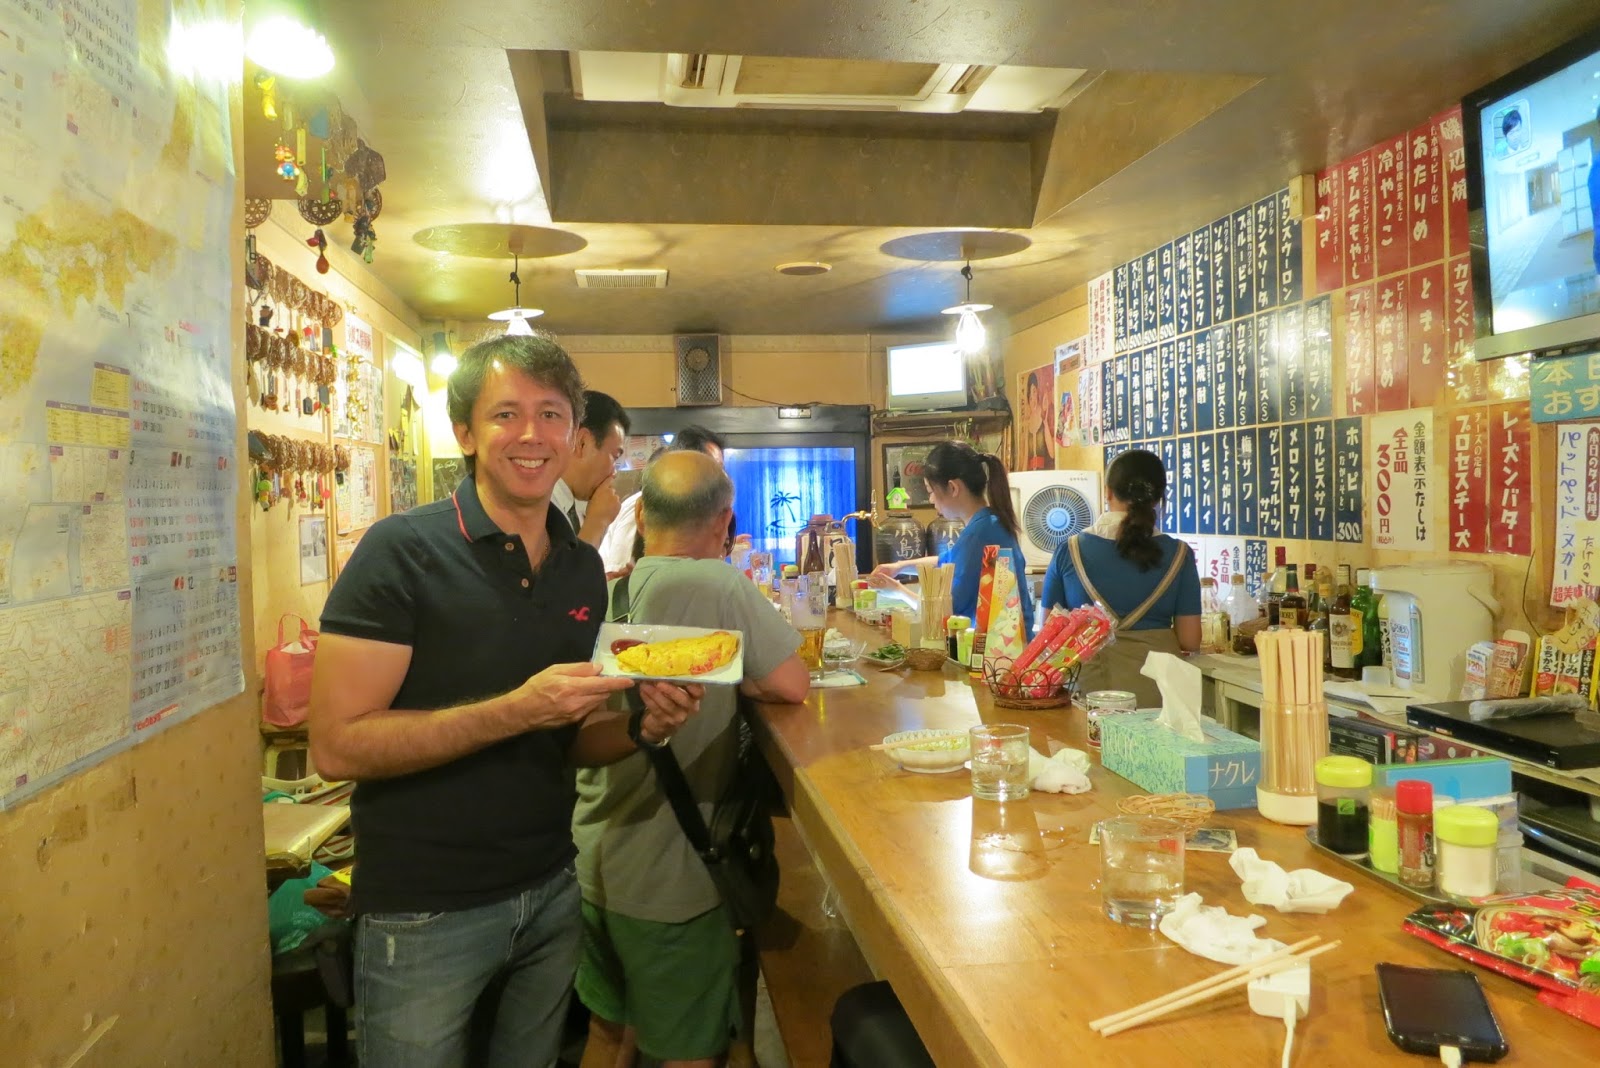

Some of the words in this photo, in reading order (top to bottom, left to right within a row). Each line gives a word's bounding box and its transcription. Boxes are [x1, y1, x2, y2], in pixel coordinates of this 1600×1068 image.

[1348, 166, 1361, 280] キムチもやし
[1378, 150, 1394, 246] 冷やっこ
[1413, 136, 1428, 241] あたりめ
[1147, 256, 1156, 323] 赤ワイン
[1162, 248, 1172, 317] 白ワイン
[1194, 233, 1204, 325] ジントニック
[1214, 225, 1224, 320] ソルティドッグ
[1258, 206, 1268, 307] カシスソーダ
[1282, 195, 1292, 301] カシスウーロン
[1131, 261, 1141, 332] スーパードライ
[1378, 289, 1394, 388] えだまめ
[1420, 277, 1433, 365] とまと
[1196, 342, 1206, 404] 芋焼酎
[1237, 324, 1247, 425] カティサーク(S)
[1259, 316, 1269, 421] ホワイトホース(S)
[1165, 443, 1173, 530] ウーロンハイ
[1182, 442, 1192, 518] 緑茶ハイ
[1201, 441, 1211, 525] レモンハイ
[1222, 434, 1231, 531] しょうがハイ
[1241, 435, 1253, 523] 梅サワー
[1289, 428, 1300, 536] メロンサワー
[1314, 424, 1326, 536] カルピスサワー
[1346, 426, 1359, 512] ホッピー
[1377, 444, 1391, 534] 300円
[1393, 427, 1408, 474] 全品
[1413, 421, 1426, 541] 金額表示なしは
[1454, 415, 1471, 549] プロセスチーズ
[1501, 411, 1520, 548] レーズンバター
[1588, 432, 1600, 517] 本日のタイ料理
[895, 523, 914, 559] 小島
[1260, 497, 1270, 535] サワー
[1209, 760, 1255, 789] ナクレ
